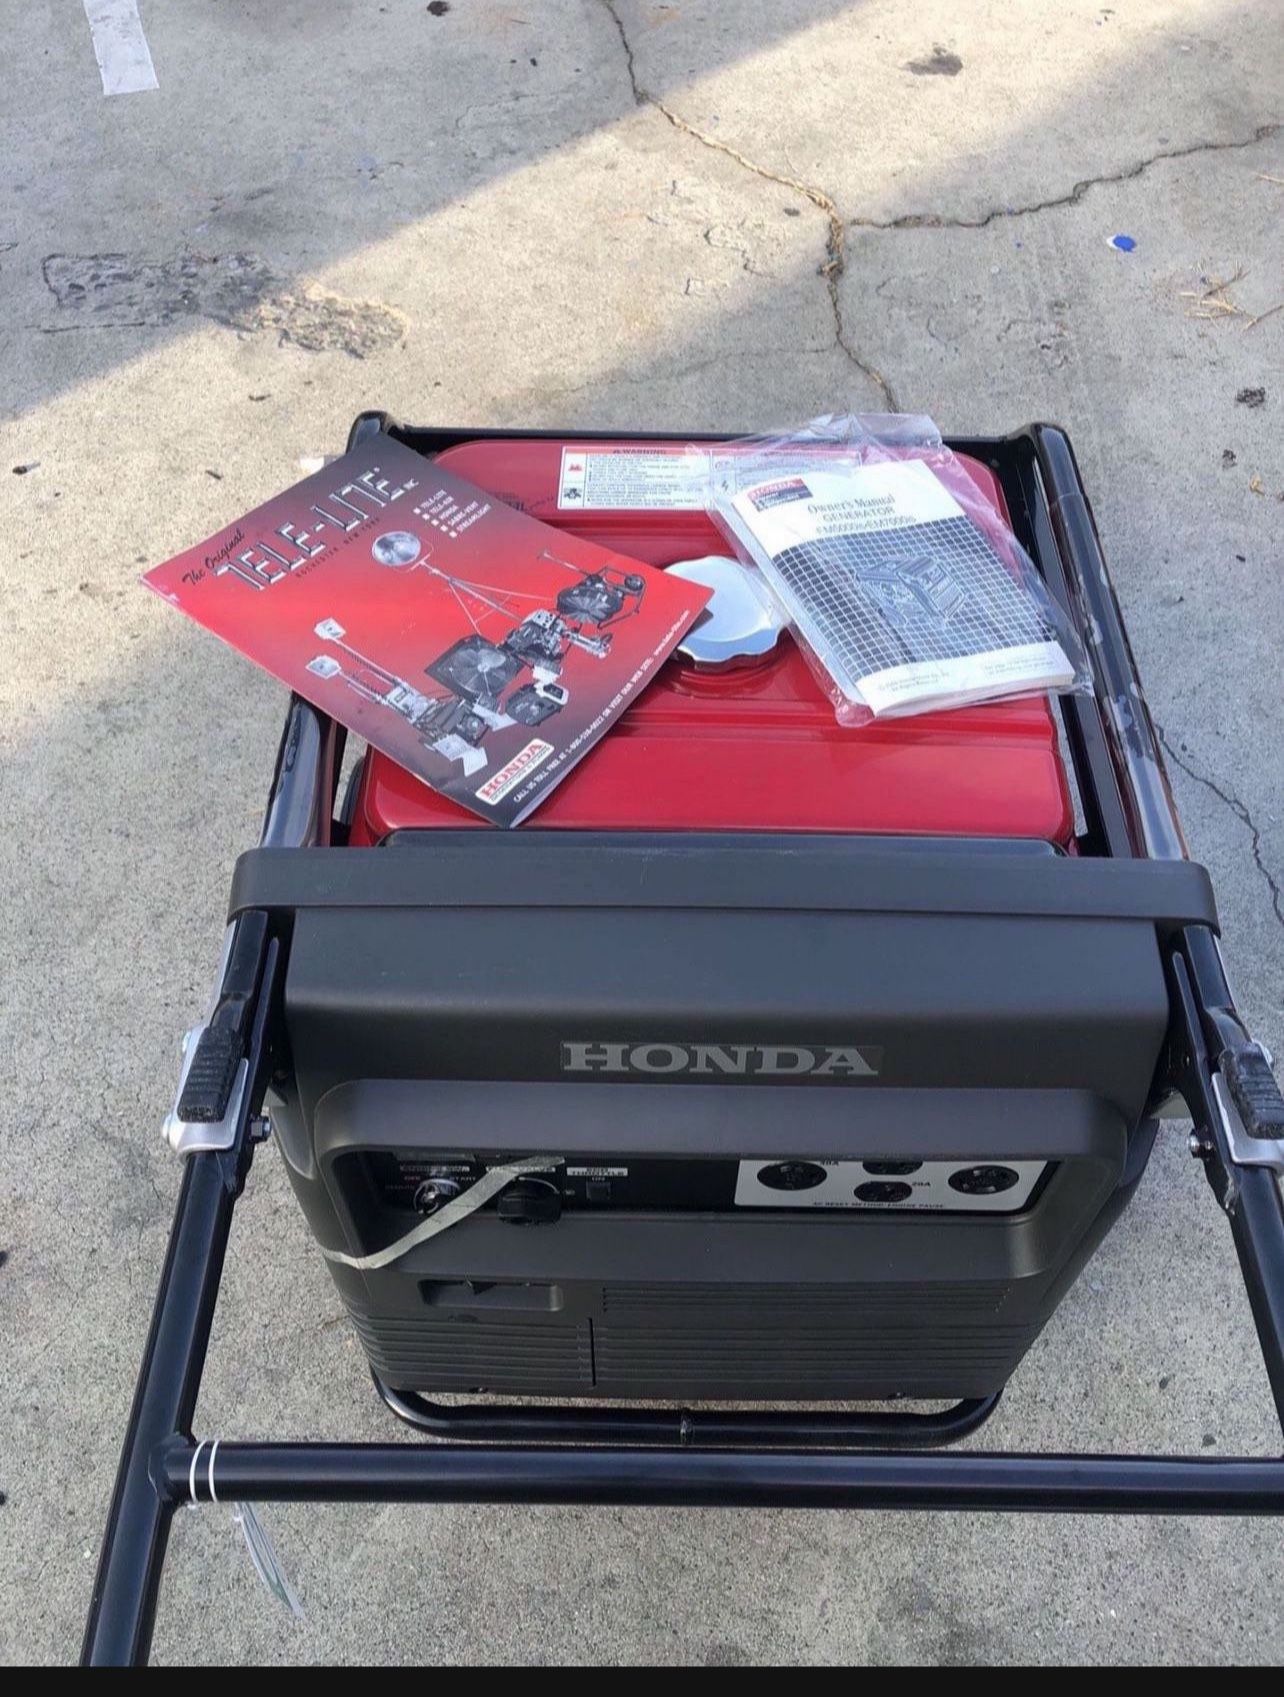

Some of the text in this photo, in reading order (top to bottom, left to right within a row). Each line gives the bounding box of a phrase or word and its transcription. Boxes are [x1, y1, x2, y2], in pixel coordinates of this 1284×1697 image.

[214, 470, 405, 591] TELE-LITE
[823, 507, 896, 523] GENERATOR
[182, 528, 245, 585] The Original
[481, 744, 542, 796] HONDA
[562, 1042, 879, 1076] HONDA
